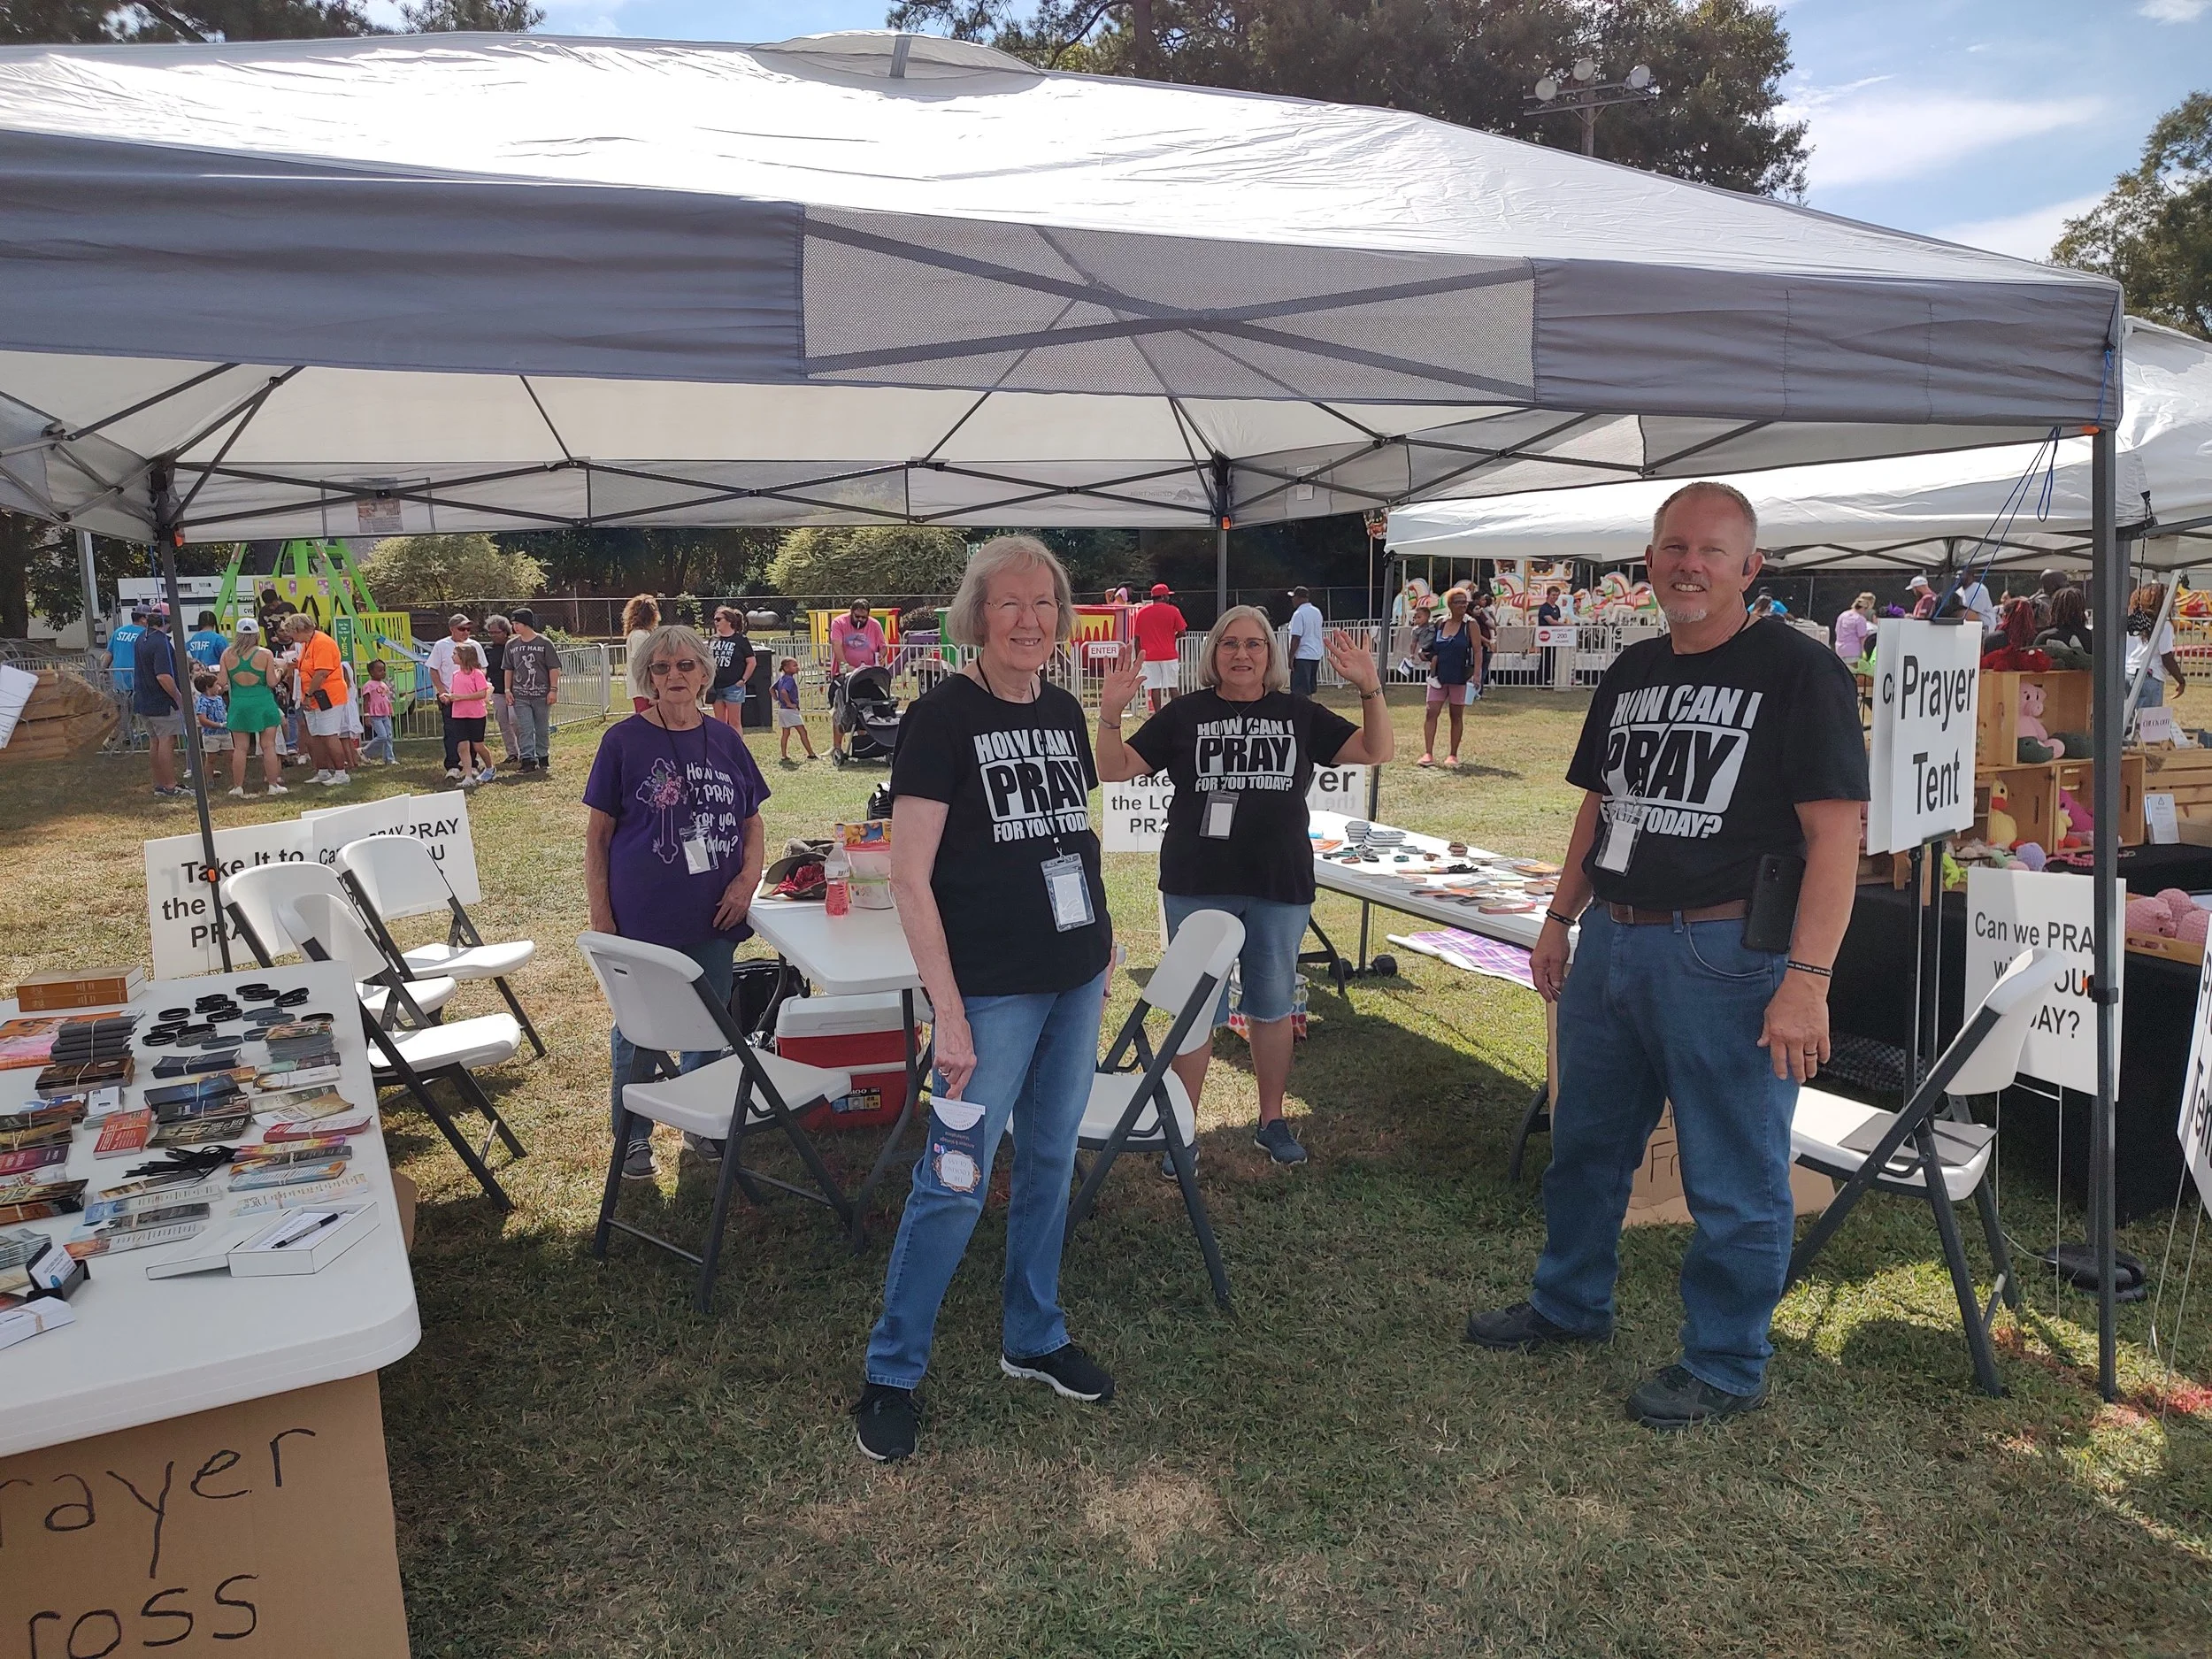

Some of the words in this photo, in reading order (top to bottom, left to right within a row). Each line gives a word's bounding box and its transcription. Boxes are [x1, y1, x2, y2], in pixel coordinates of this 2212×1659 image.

[116, 631, 139, 643] STAF
[1609, 686, 1670, 728] HOW
[1668, 685, 1744, 726] CAN
[1741, 691, 1763, 729] I
[1901, 655, 1976, 732] Prayer
[1197, 718, 1242, 736] HOW
[1247, 718, 1284, 735] CAN
[1286, 719, 1294, 734] I
[973, 729, 1031, 764] HOW
[1033, 729, 1071, 757] CAN
[1201, 737, 1292, 774] PRAY
[1194, 777, 1218, 792] FOR
[1221, 776, 1246, 790] YOU
[1248, 775, 1293, 791] TODAY?
[1604, 730, 1741, 805] PRAY
[1913, 748, 1961, 815] Tent
[703, 784, 734, 805] PRAY
[987, 760, 1087, 818] PRAY
[1111, 795, 1141, 810] the
[993, 820, 1025, 842] FOR
[1024, 816, 1056, 838] YOU
[1056, 811, 1090, 833] TOD
[1641, 806, 1723, 839] TODAY?
[254, 851, 271, 866] It
[278, 849, 304, 863] to
[319, 849, 340, 865] Ca
[162, 896, 206, 921] the
[1975, 911, 2008, 941] Can
[2014, 923, 2039, 946] we
[2047, 921, 2094, 955] PRA
[2055, 968, 2087, 997] OU
[0, 1428, 316, 1579] rayer
[28, 1574, 258, 1659] ross
